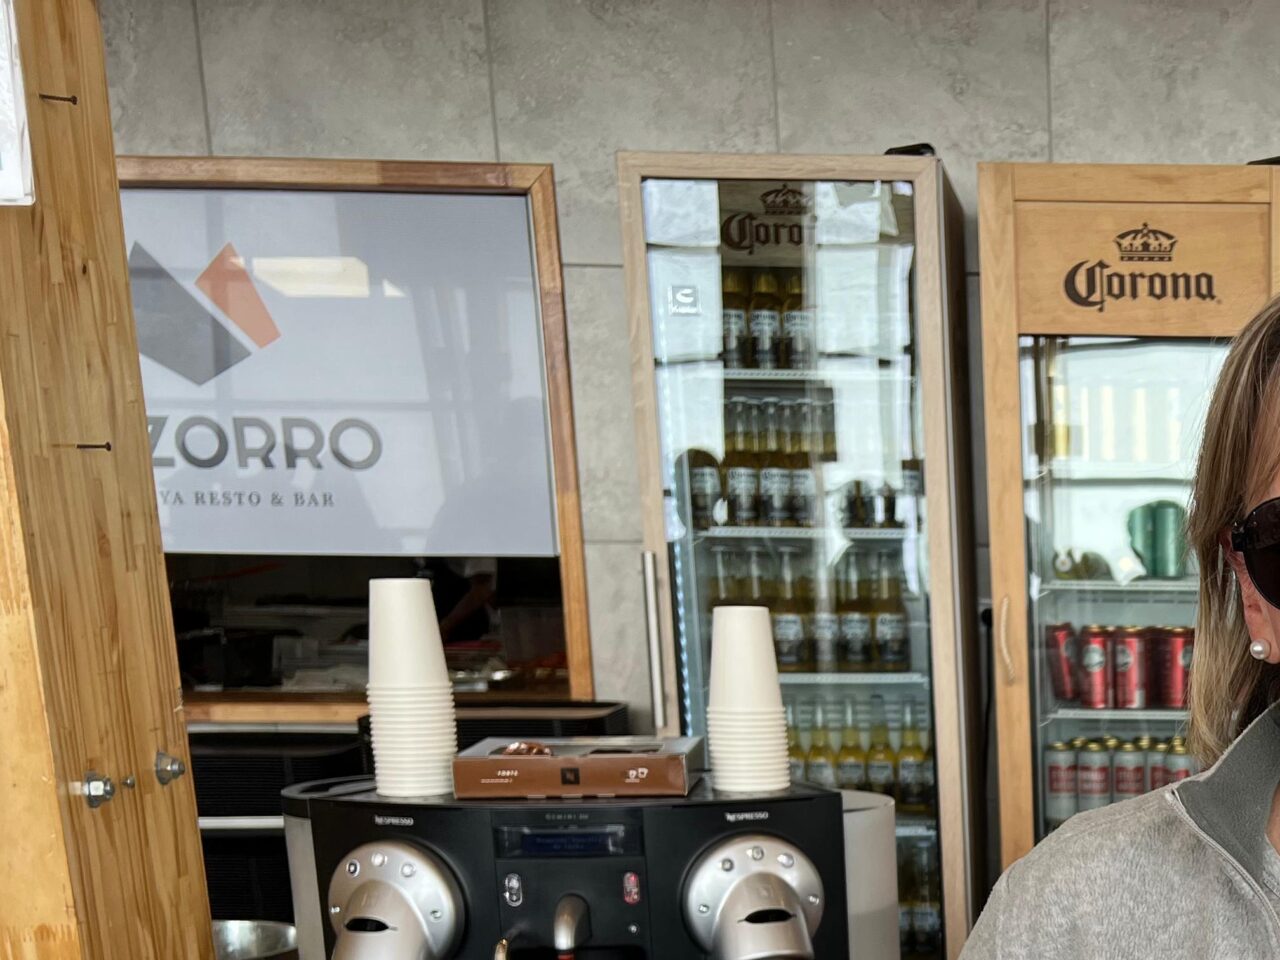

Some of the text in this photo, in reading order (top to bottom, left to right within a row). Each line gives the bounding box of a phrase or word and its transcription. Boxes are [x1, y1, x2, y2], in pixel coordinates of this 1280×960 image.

[721, 213, 804, 255] Coro
[1063, 258, 1217, 313] Corona
[146, 415, 383, 471] ZORRO
[194, 490, 262, 507] RESTO
[270, 491, 285, 507] &
[293, 491, 335, 507] BAR
